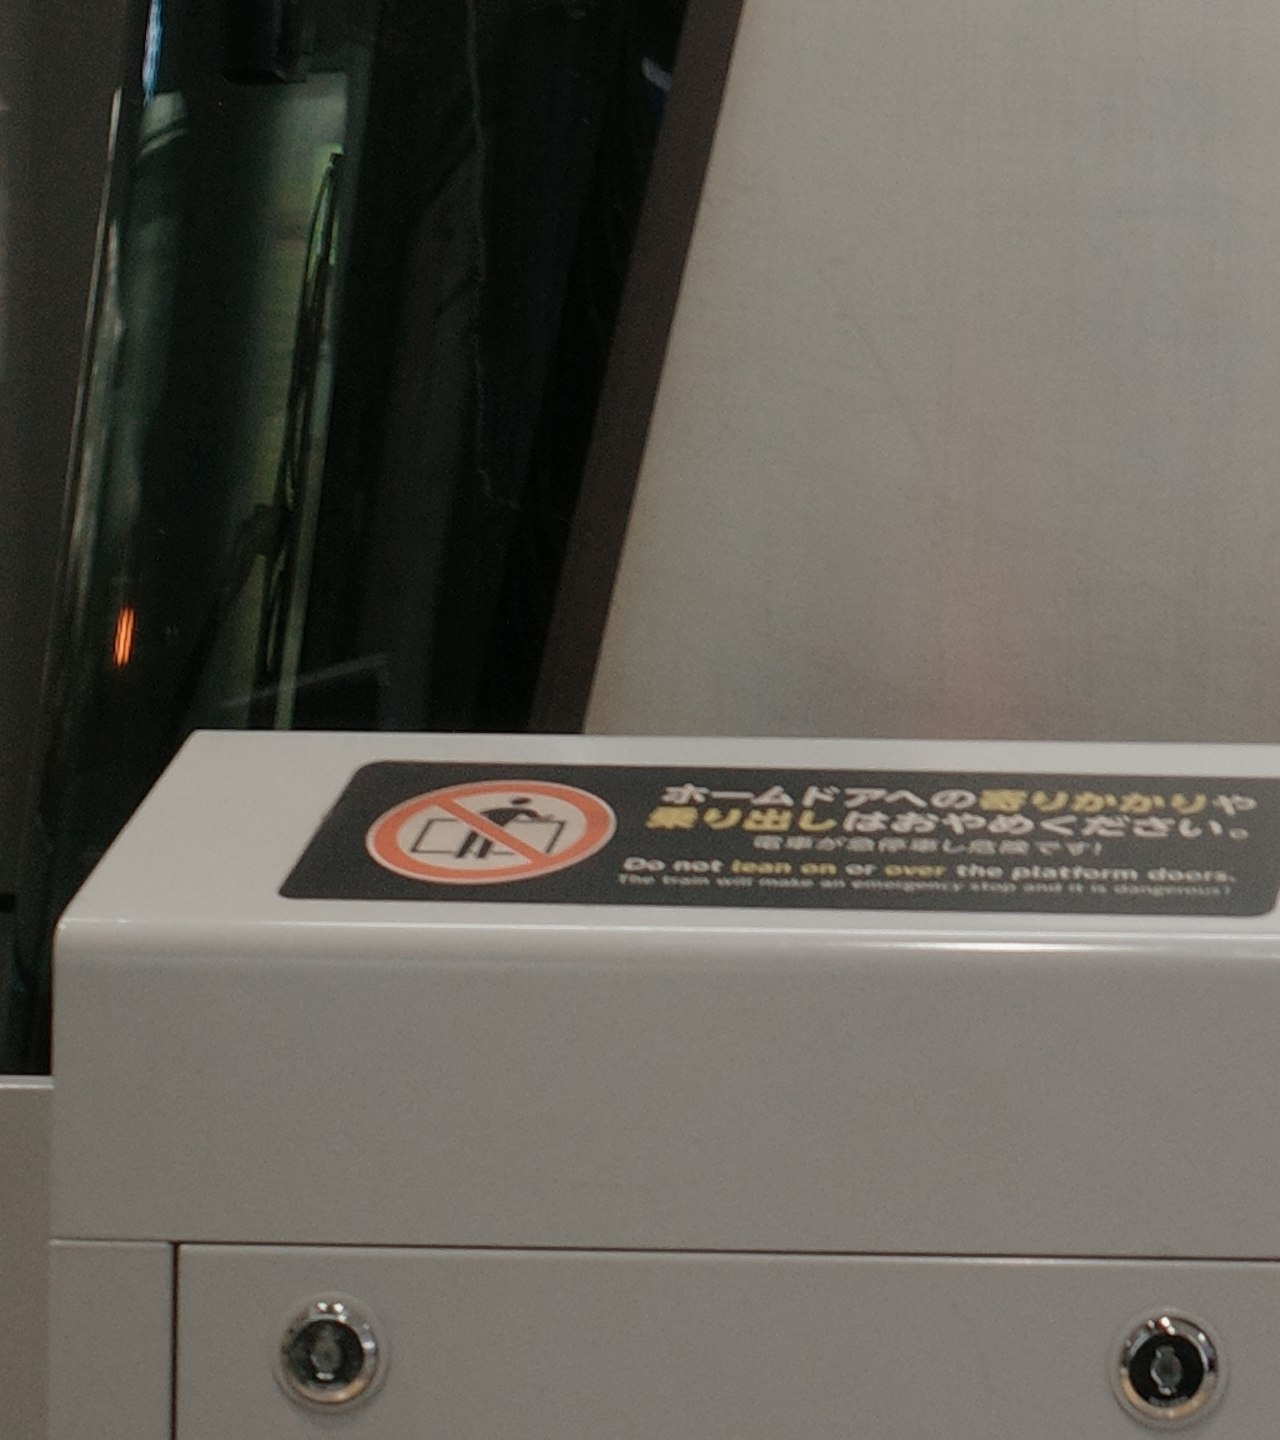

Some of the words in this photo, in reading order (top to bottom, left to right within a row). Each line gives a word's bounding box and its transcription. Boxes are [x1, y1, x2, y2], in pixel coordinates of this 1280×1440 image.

[623, 857, 666, 872] Do
[672, 859, 725, 873] not
[731, 859, 792, 874] lean
[801, 862, 838, 875] on
[845, 863, 877, 876] or
[884, 864, 948, 877] over
[956, 863, 1004, 878] the
[1011, 865, 1138, 881] platform
